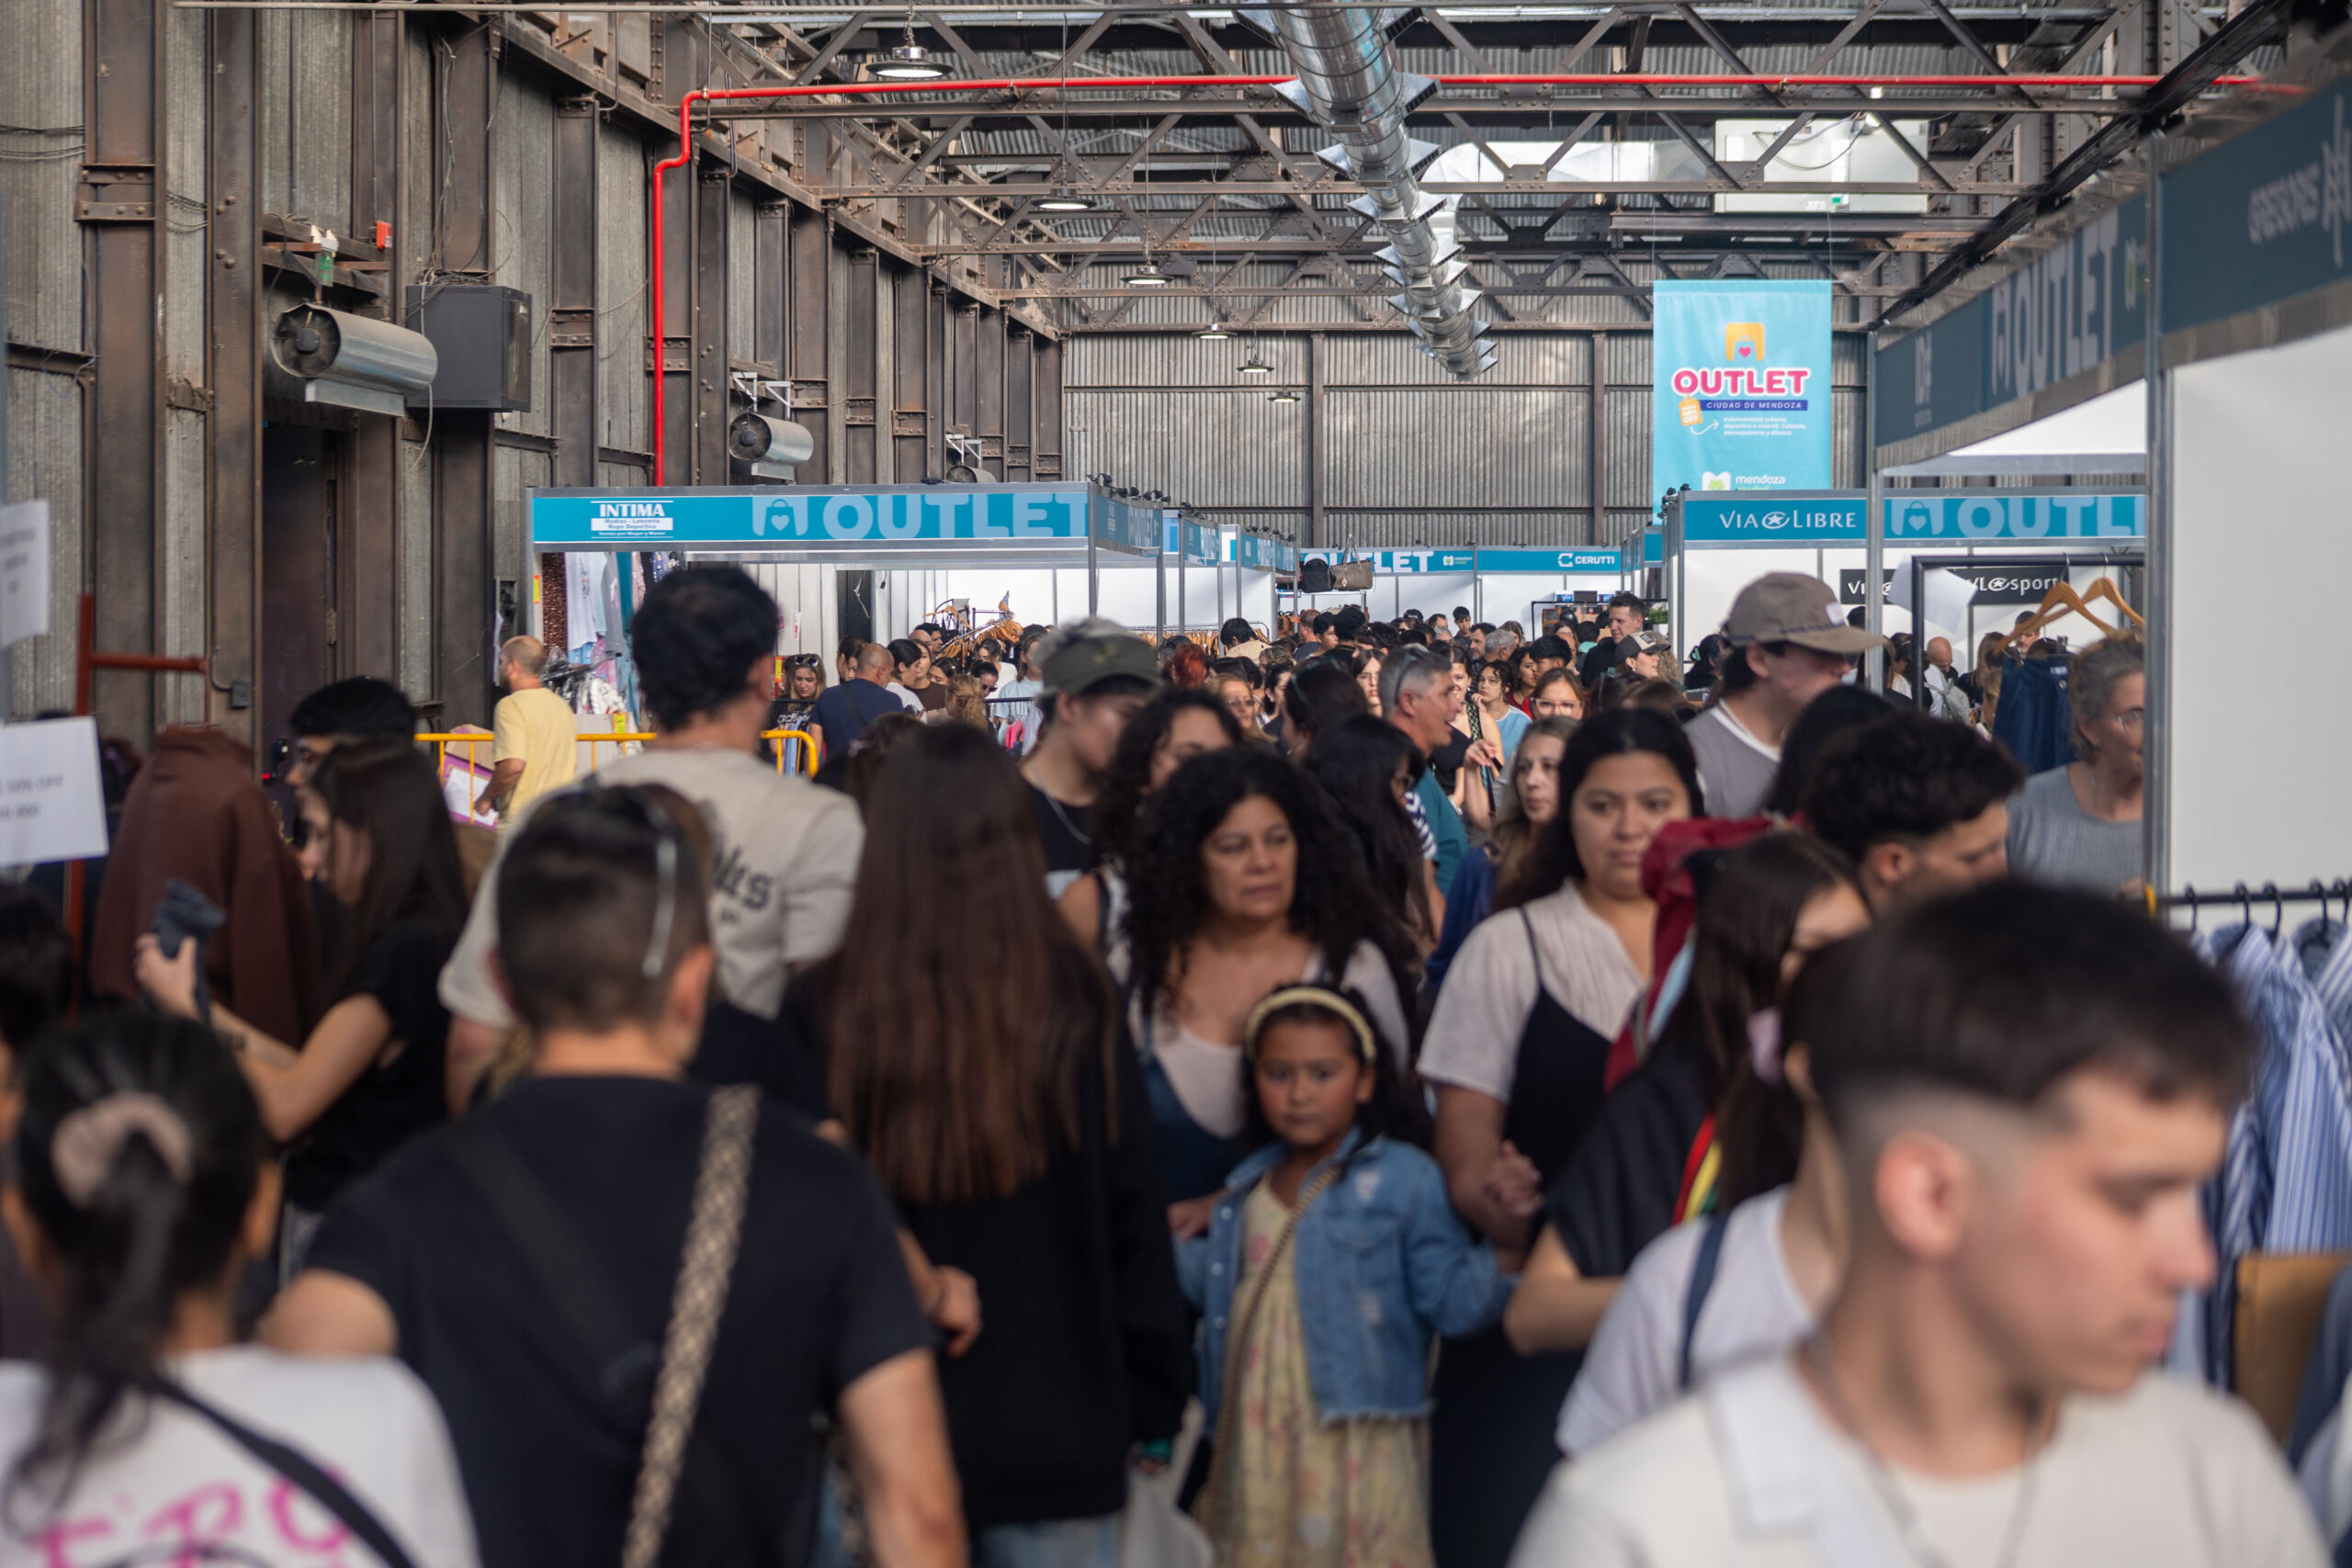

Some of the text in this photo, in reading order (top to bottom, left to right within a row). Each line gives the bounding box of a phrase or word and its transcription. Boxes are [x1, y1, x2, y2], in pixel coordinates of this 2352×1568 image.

[2014, 208, 2119, 398] OUTLET
[1672, 368, 1810, 396] OUTLET
[1735, 474, 1786, 485] mendoza
[600, 503, 665, 517] INTIMA
[822, 492, 1088, 539] OUTLET
[1720, 510, 1858, 529] VIA LIBRE
[1957, 496, 2146, 538] OUTL
[1575, 556, 1615, 564] CERUTTI
[2010, 578, 2059, 596] sport
